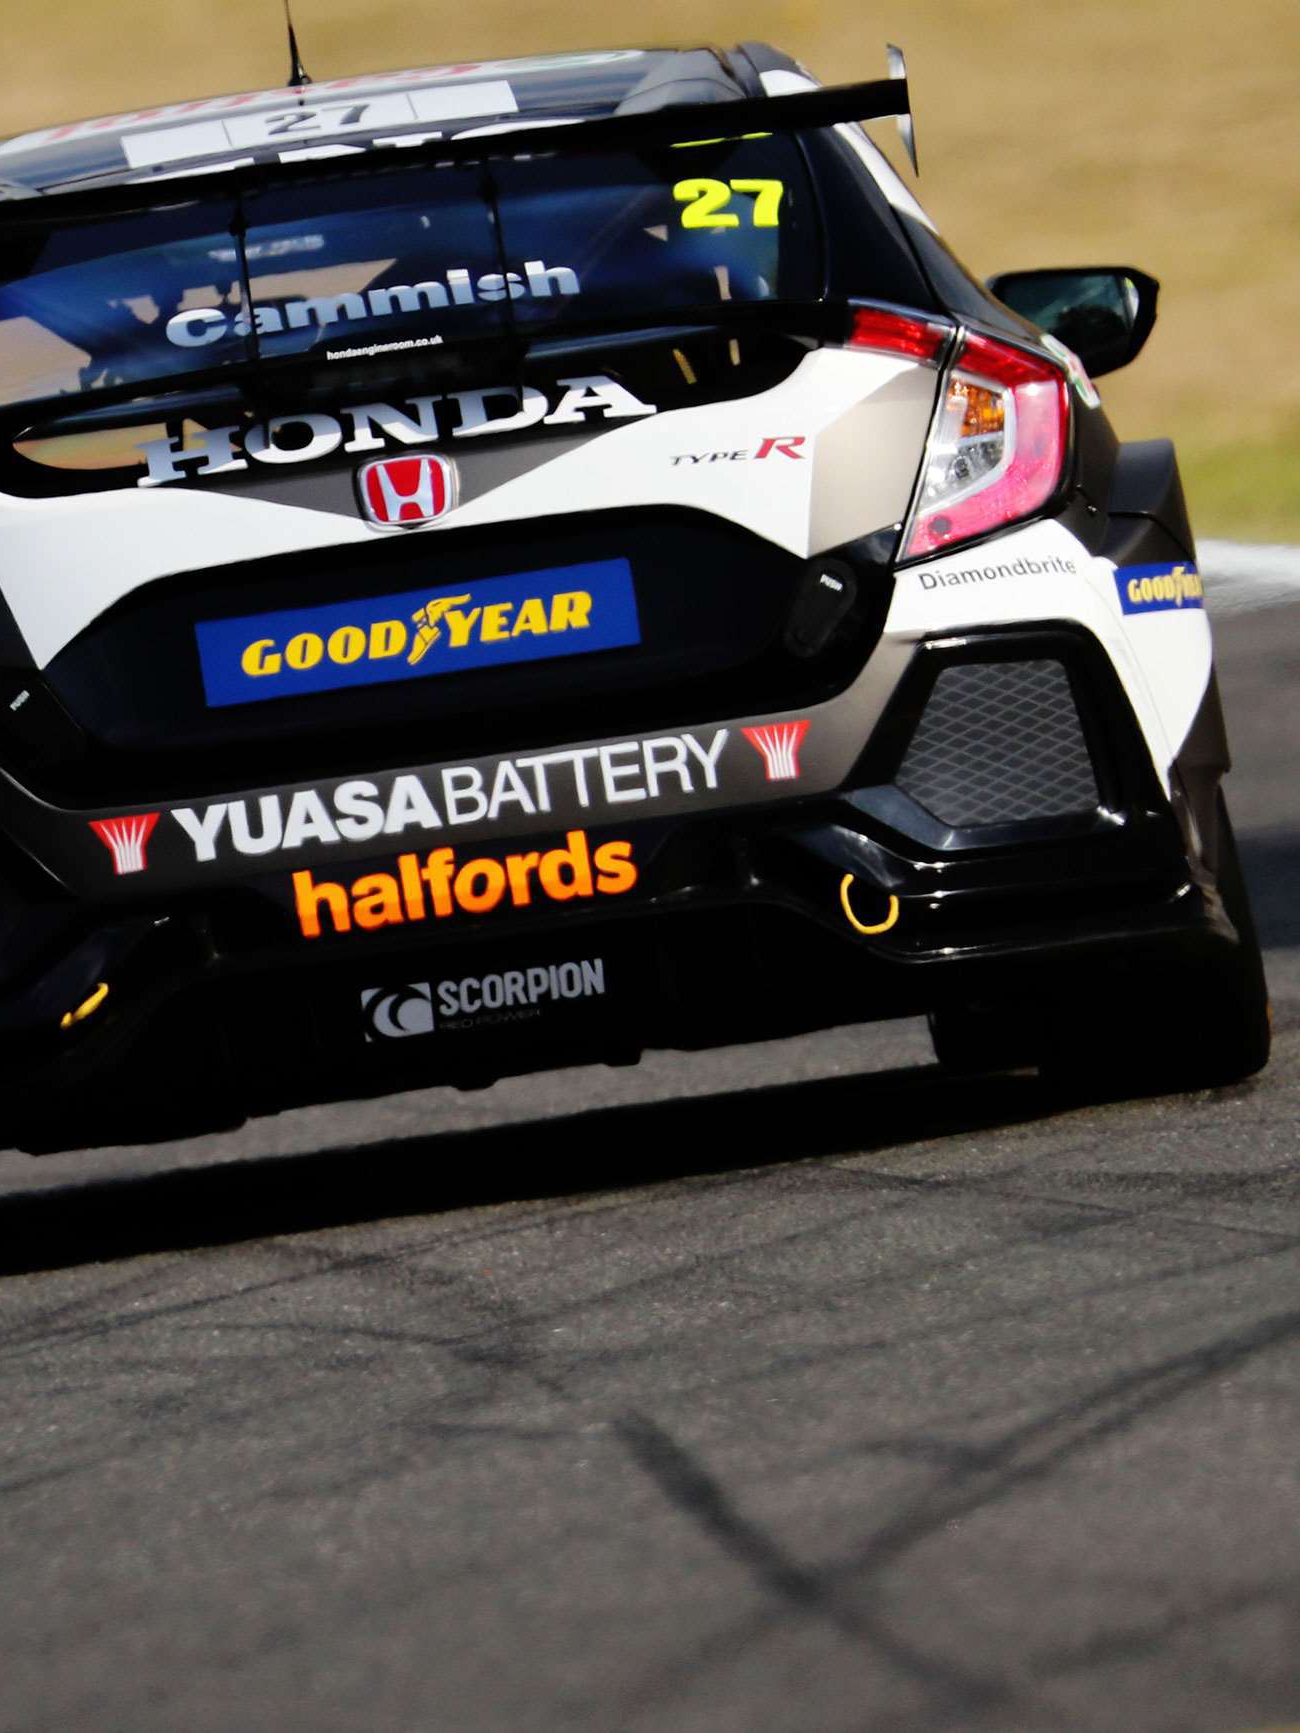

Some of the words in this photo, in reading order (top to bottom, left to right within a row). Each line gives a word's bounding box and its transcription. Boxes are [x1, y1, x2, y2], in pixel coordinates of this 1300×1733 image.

[264, 103, 373, 137] 27
[673, 178, 784, 229] 27
[166, 260, 580, 347] Cammish
[326, 335, 444, 360] hondaengineroom.co.uk
[137, 375, 657, 488] HONDA
[669, 450, 749, 466] TYPE
[753, 436, 806, 460] R
[918, 555, 1077, 590] Diamondbrite
[241, 591, 593, 677] GOODYEAR
[292, 829, 638, 938] halfords
[437, 958, 606, 1016] SCORPION
